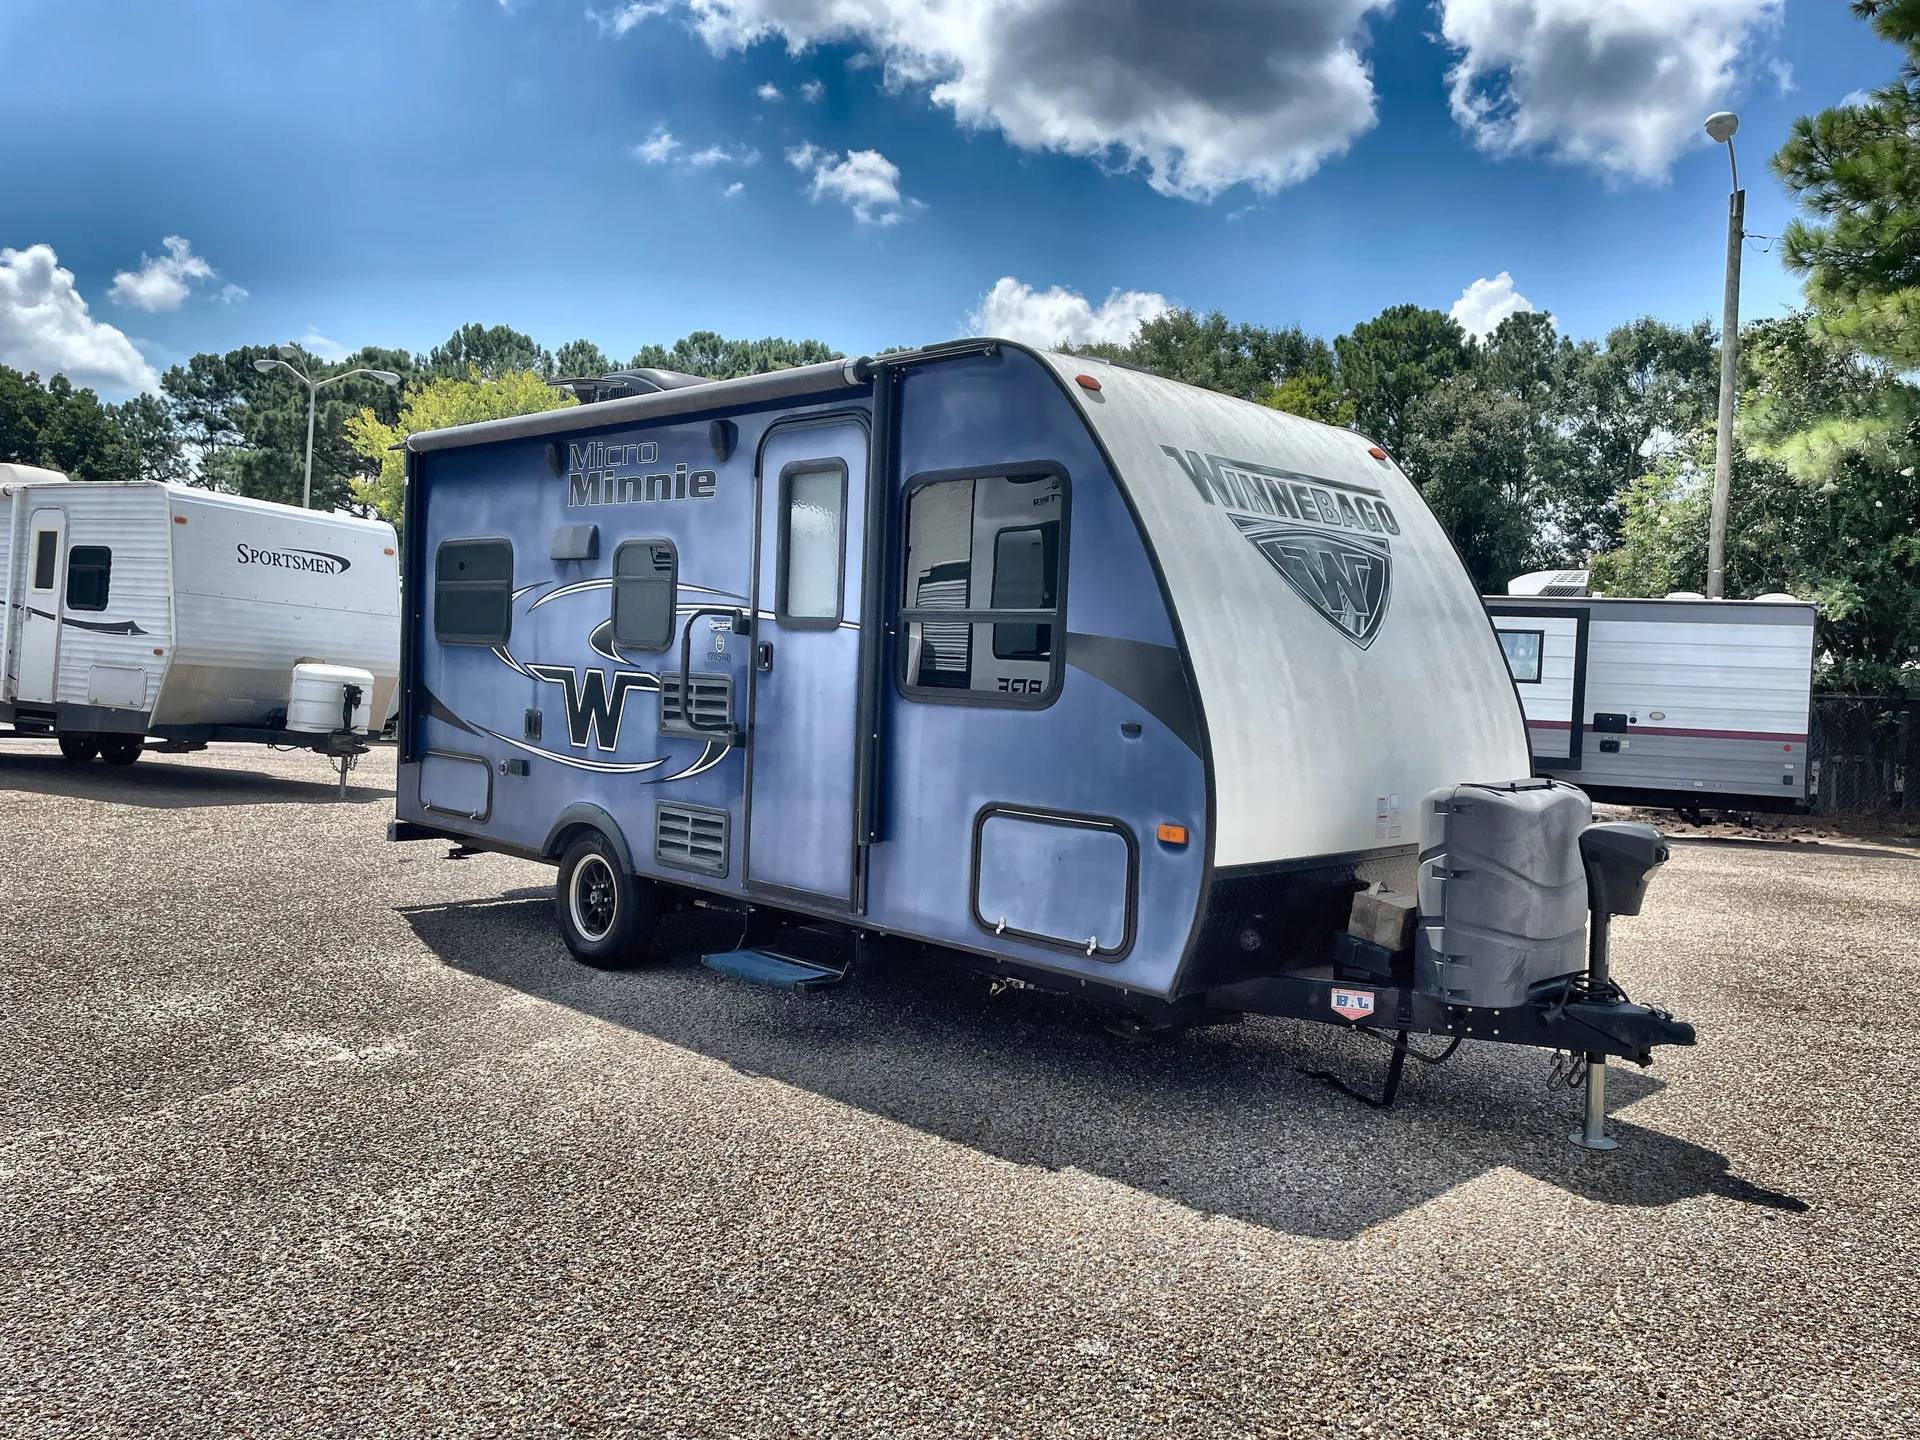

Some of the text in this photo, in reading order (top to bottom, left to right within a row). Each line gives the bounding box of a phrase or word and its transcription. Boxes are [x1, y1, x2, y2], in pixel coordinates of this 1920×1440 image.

[568, 463, 717, 508] Minnie
[569, 441, 658, 470] Micro
[1159, 444, 1401, 536] WINNEBAGO
[1277, 543, 1371, 617] W
[524, 664, 661, 752] W
